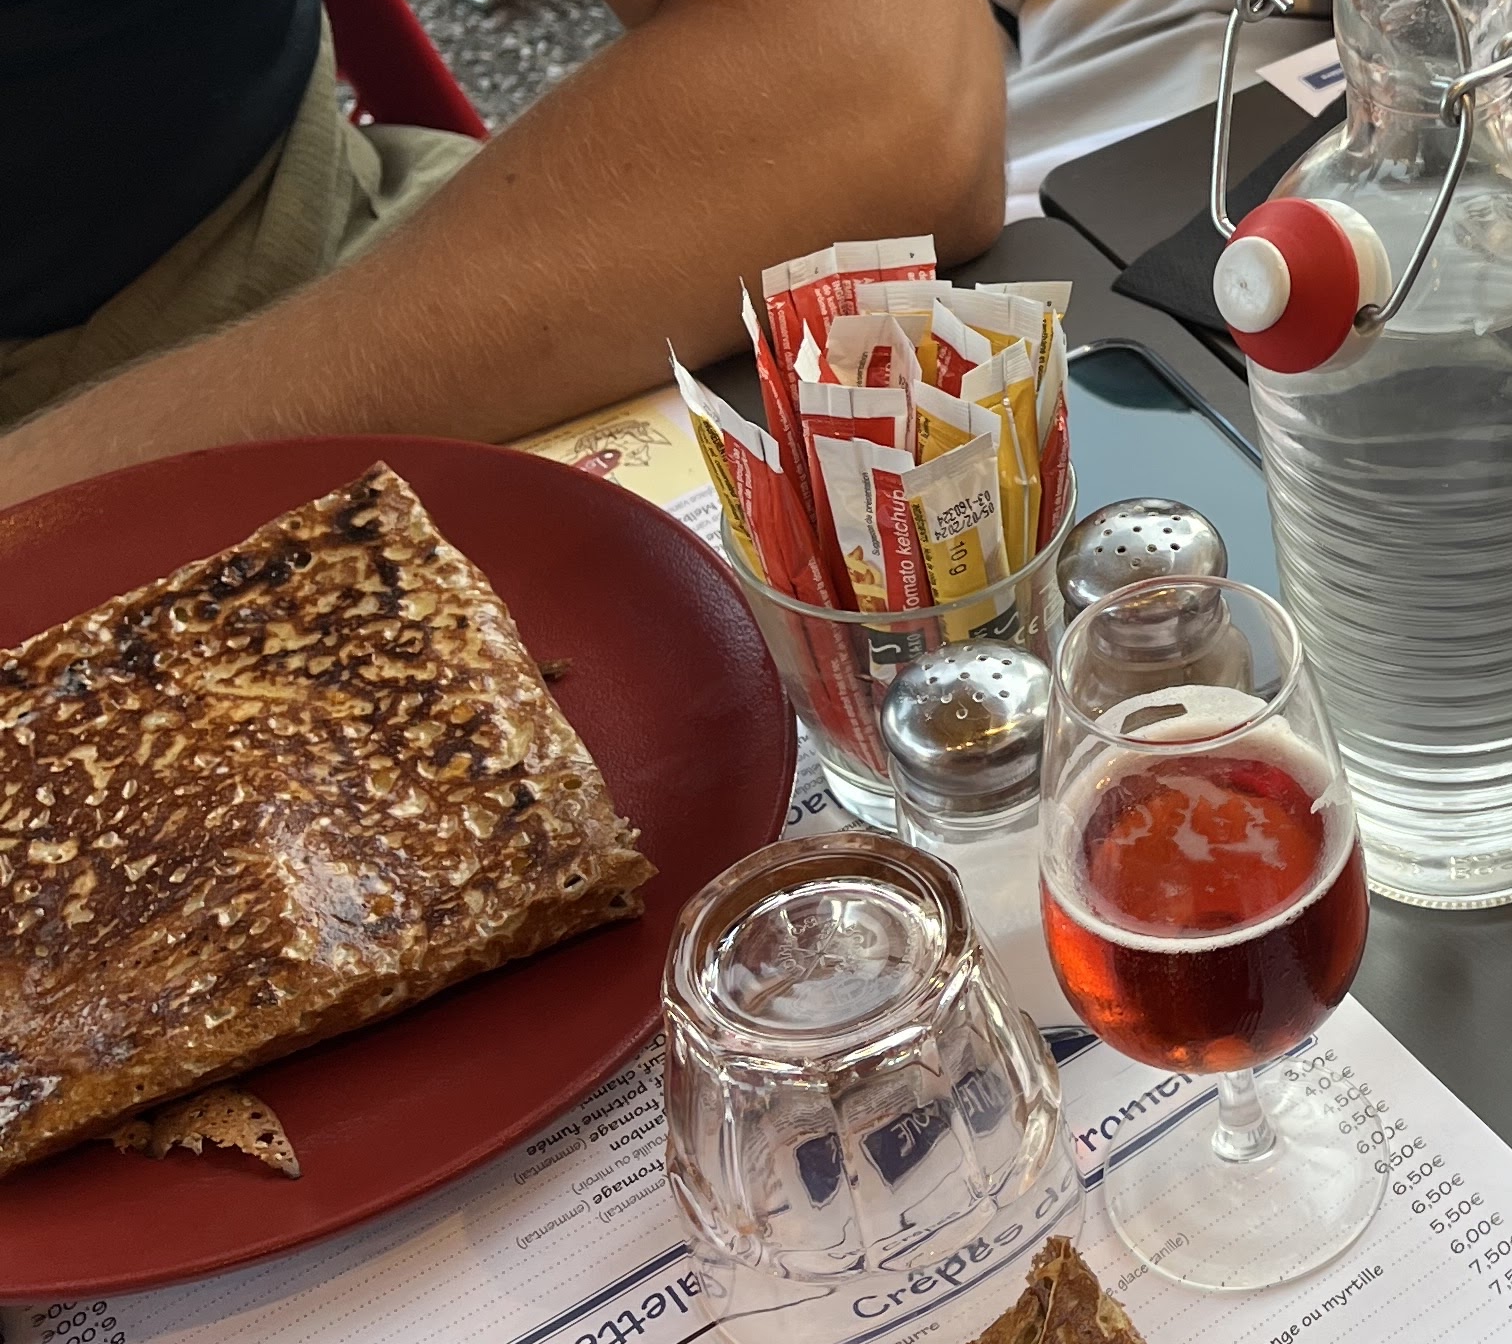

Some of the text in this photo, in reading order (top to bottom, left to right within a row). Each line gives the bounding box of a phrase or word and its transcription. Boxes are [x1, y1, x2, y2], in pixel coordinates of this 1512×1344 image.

[889, 489, 911, 555] ketchup
[949, 541, 968, 562] 10
[525, 1084, 648, 1157] poitrine fumée
[589, 1098, 661, 1143] fromage
[1375, 1136, 1427, 1174] 6,50€
[1393, 1154, 1446, 1195] 6,50€
[592, 1158, 665, 1205] fromage
[1412, 1173, 1465, 1215] 6,50€
[1430, 1192, 1484, 1234] 5,50€
[1450, 1212, 1504, 1254] 6,00€
[1302, 1308, 1322, 1328] ou
[1322, 1262, 1385, 1312] myrtille
[41, 1301, 107, 1344] 6,00€
